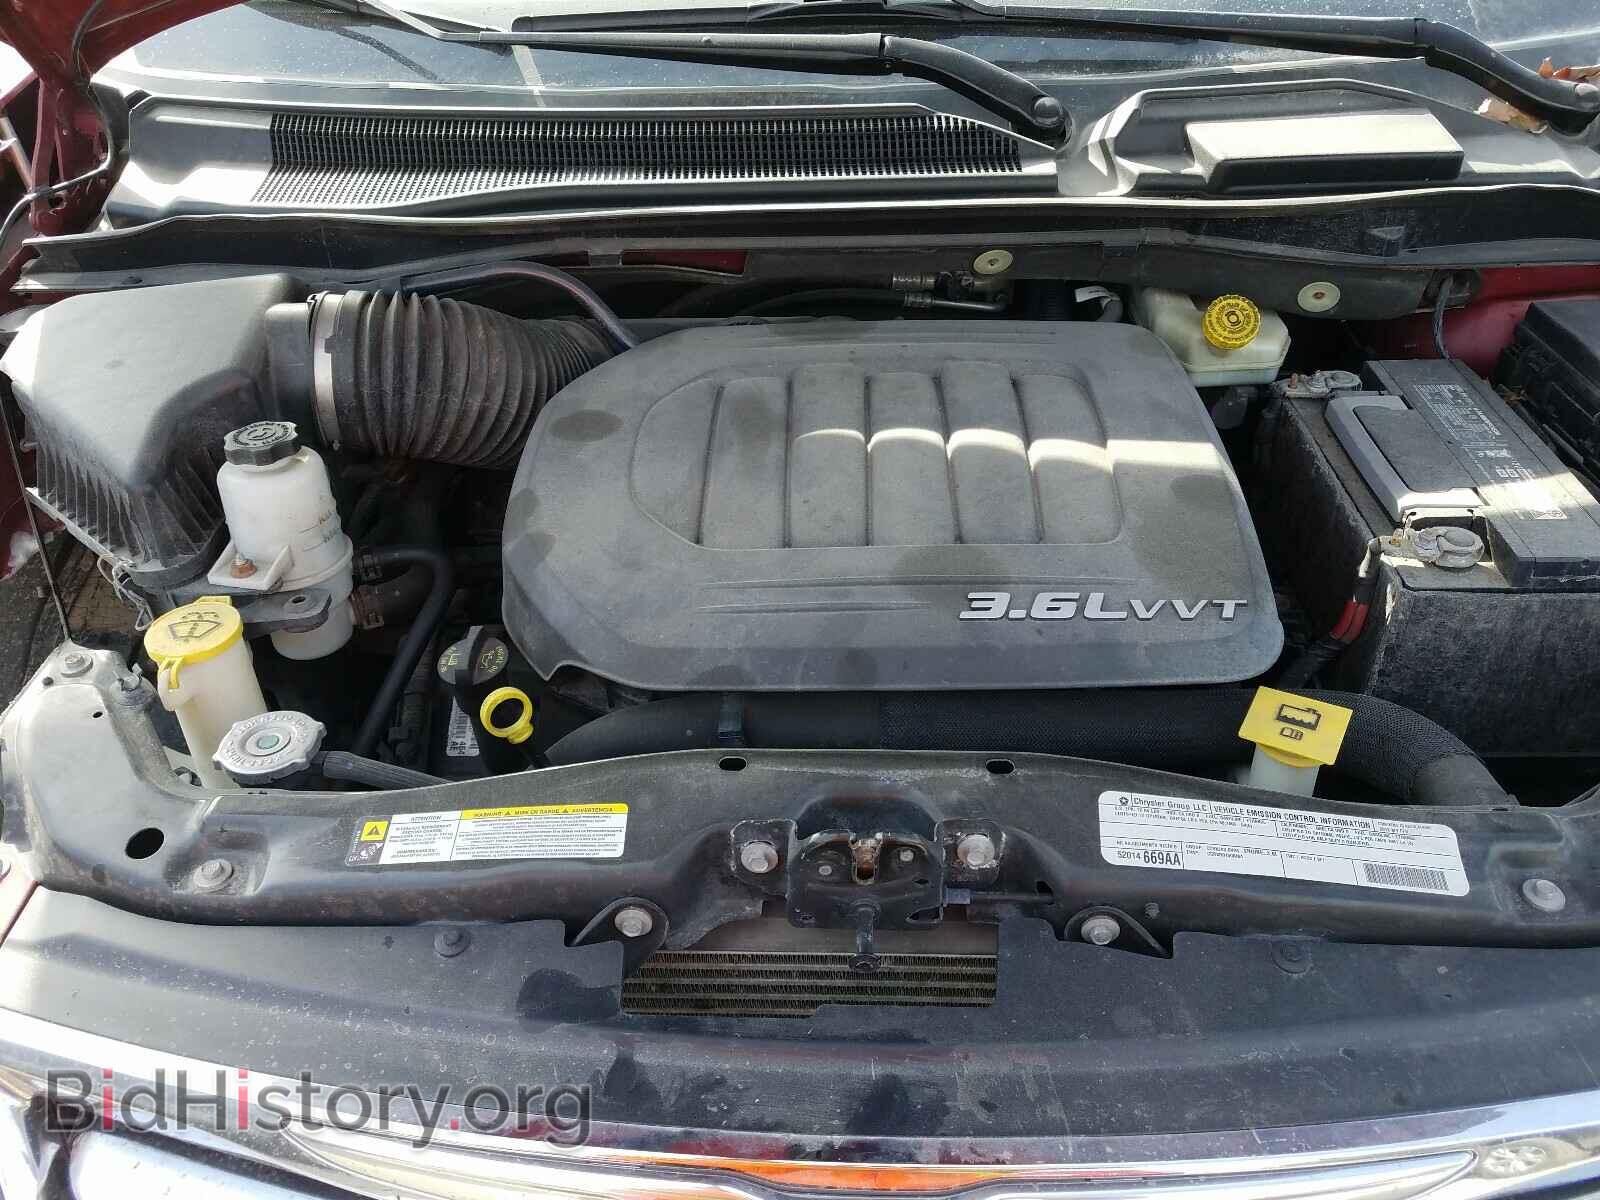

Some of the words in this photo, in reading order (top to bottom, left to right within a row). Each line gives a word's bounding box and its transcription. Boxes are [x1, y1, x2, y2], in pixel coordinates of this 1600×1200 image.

[1134, 797, 1165, 807] Chrysler
[1168, 801, 1190, 811] Group
[1193, 803, 1207, 812] LLC
[1214, 805, 1245, 816] VEHICLE
[1246, 808, 1282, 820] EMISSION
[1283, 813, 1318, 824] CONTROL
[1320, 817, 1371, 830] INFORMATION
[1143, 850, 1181, 866] 669AA
